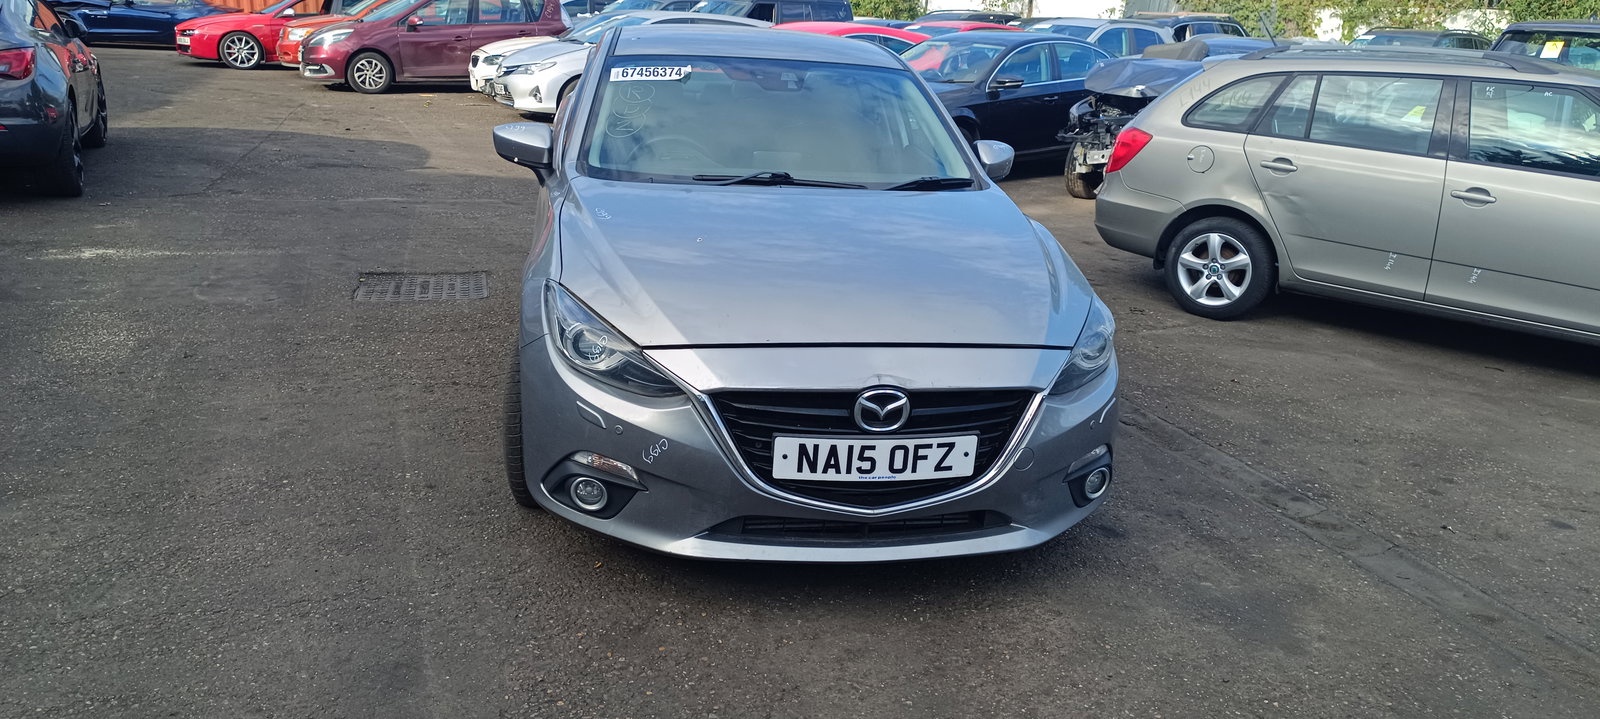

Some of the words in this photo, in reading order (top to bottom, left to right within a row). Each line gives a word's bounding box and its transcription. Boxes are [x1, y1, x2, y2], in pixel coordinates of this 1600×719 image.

[621, 67, 683, 78] 67456374
[797, 443, 877, 475] NA15
[888, 442, 956, 475] OFZ
